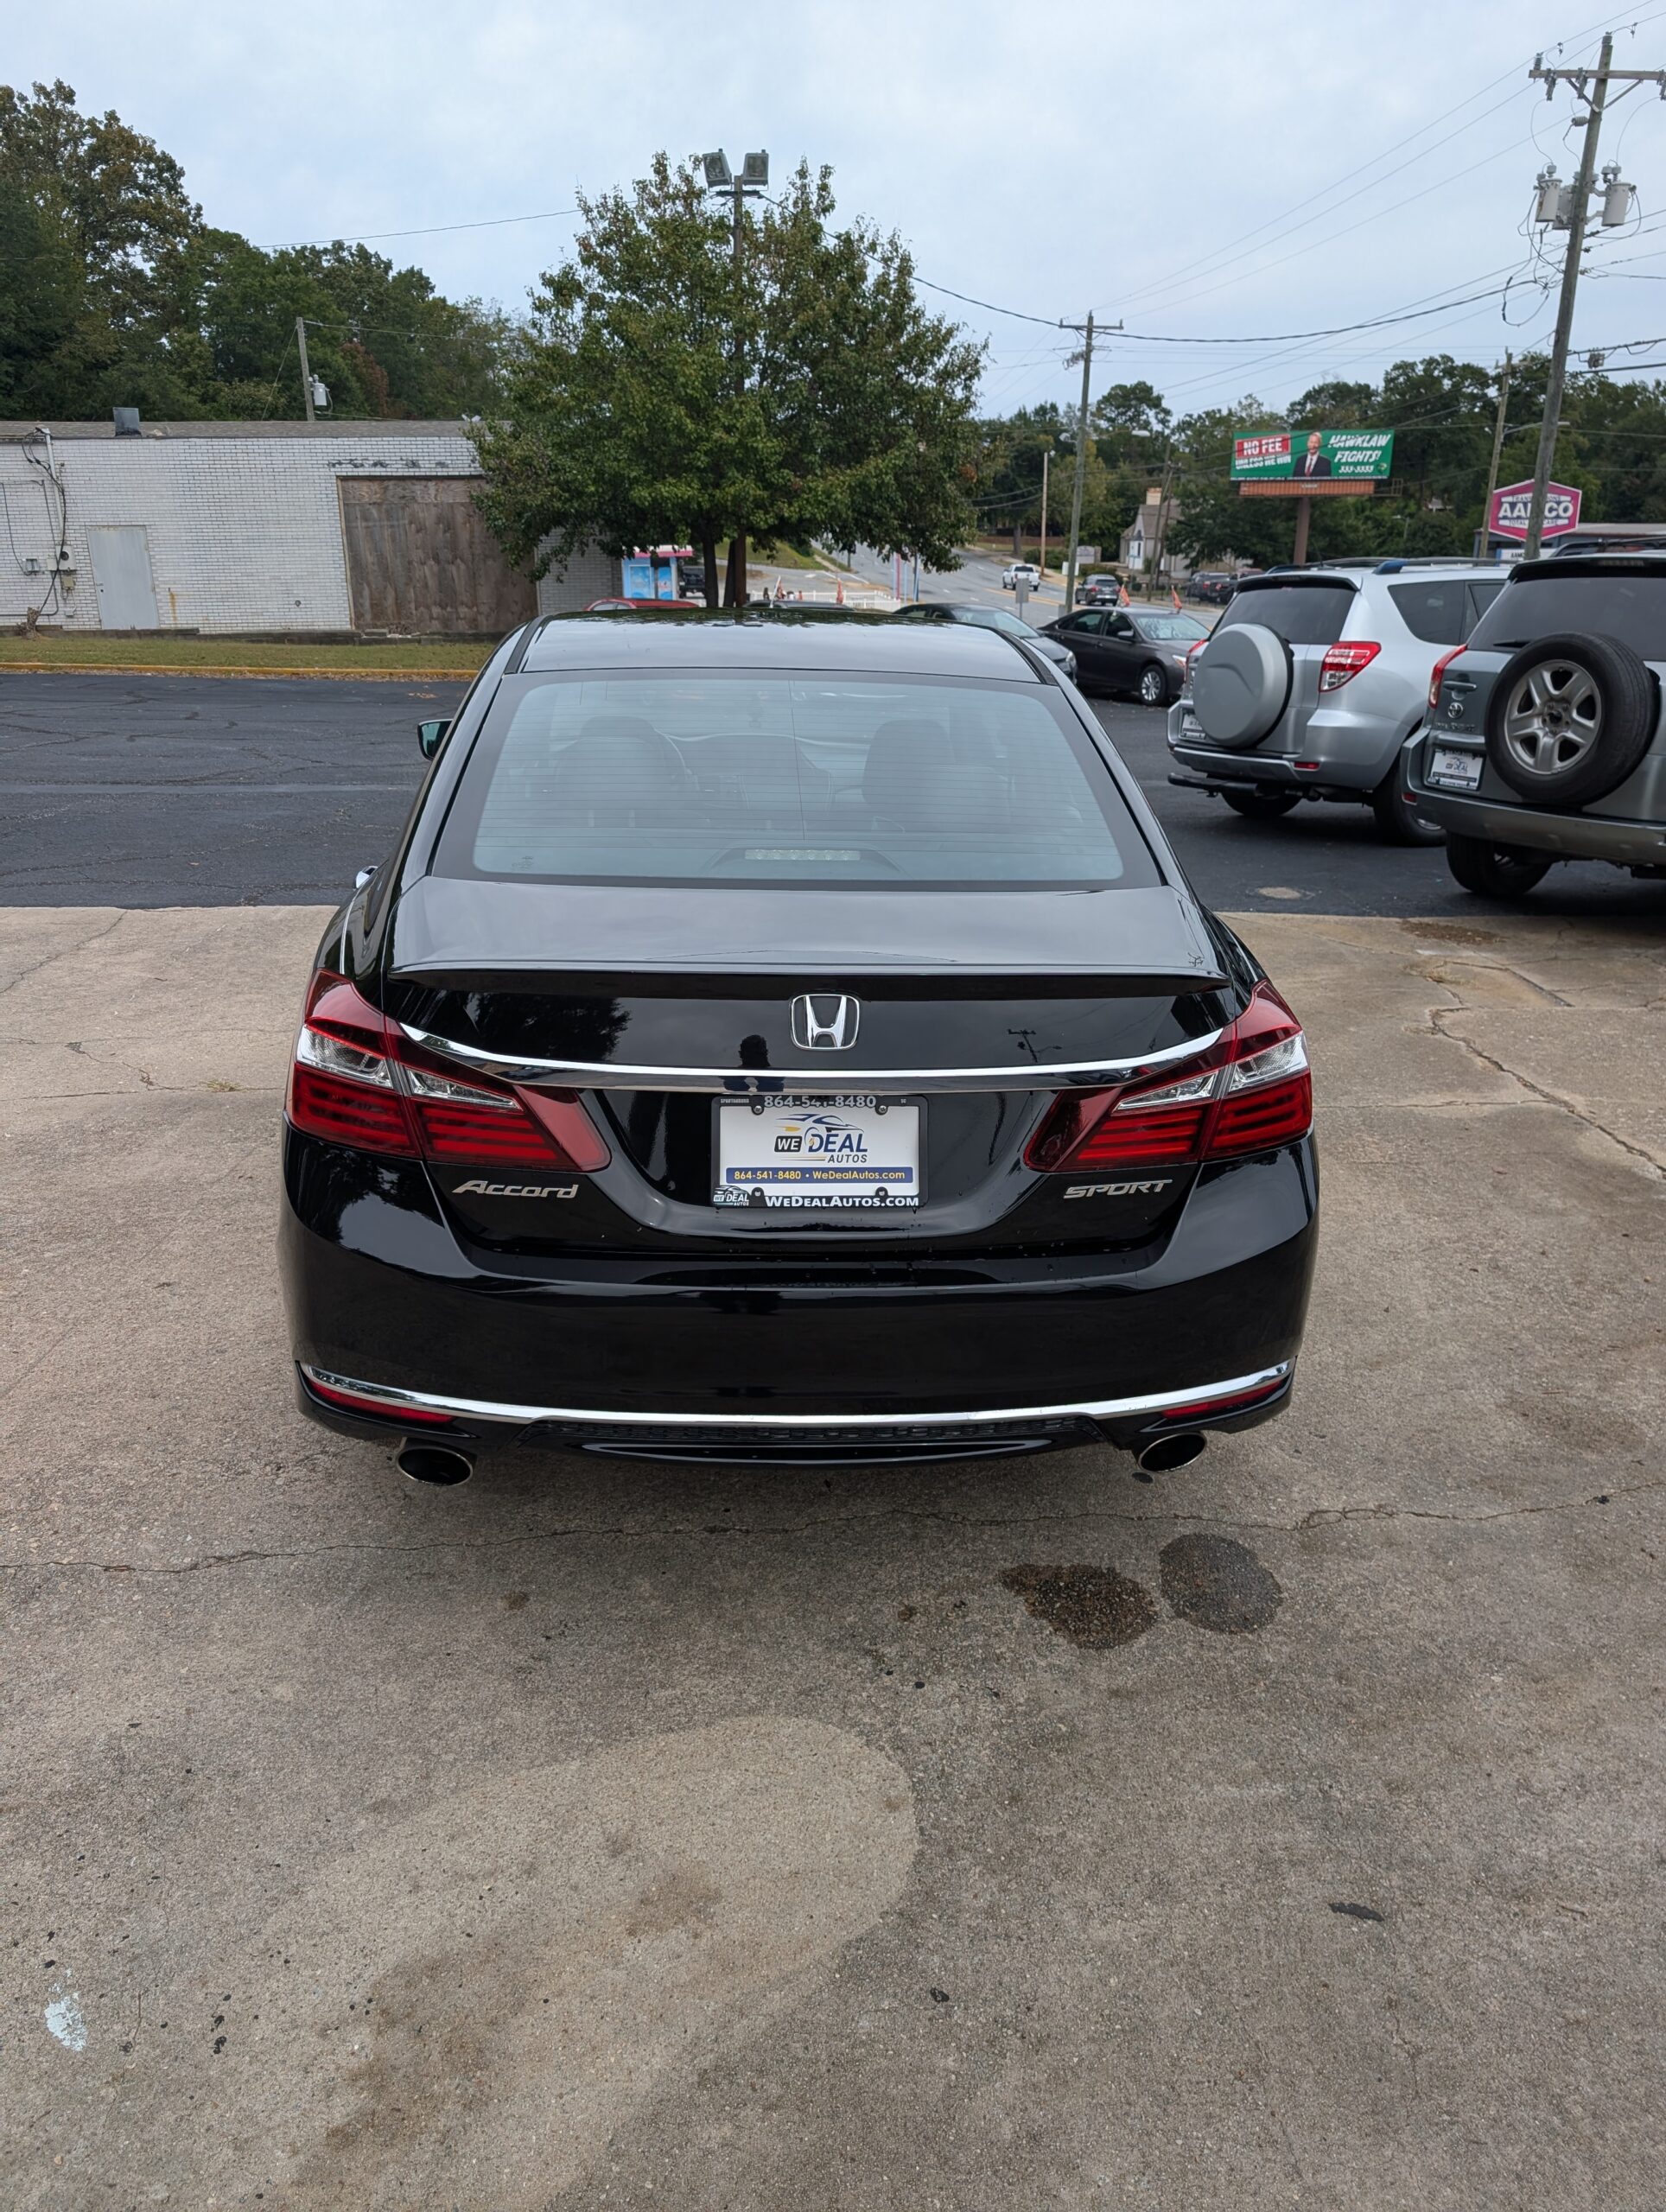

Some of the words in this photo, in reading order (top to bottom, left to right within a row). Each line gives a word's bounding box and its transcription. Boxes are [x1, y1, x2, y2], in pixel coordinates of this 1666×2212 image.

[1243, 440, 1260, 455] NO
[1262, 437, 1282, 454] FEE
[1327, 434, 1391, 448] HAWKLAW
[1334, 450, 1382, 462] FIGHTS!
[1498, 502, 1574, 518] AACO
[778, 1138, 800, 1151] WE
[808, 1133, 868, 1153] DEAL
[828, 1154, 868, 1163] AUTOS
[734, 1170, 801, 1180] 864-541-8480
[812, 1170, 906, 1179] WeDealAutos.com
[452, 1179, 579, 1198] Accord
[1064, 1179, 1173, 1199] SPORT
[726, 1193, 749, 1202] DEAL
